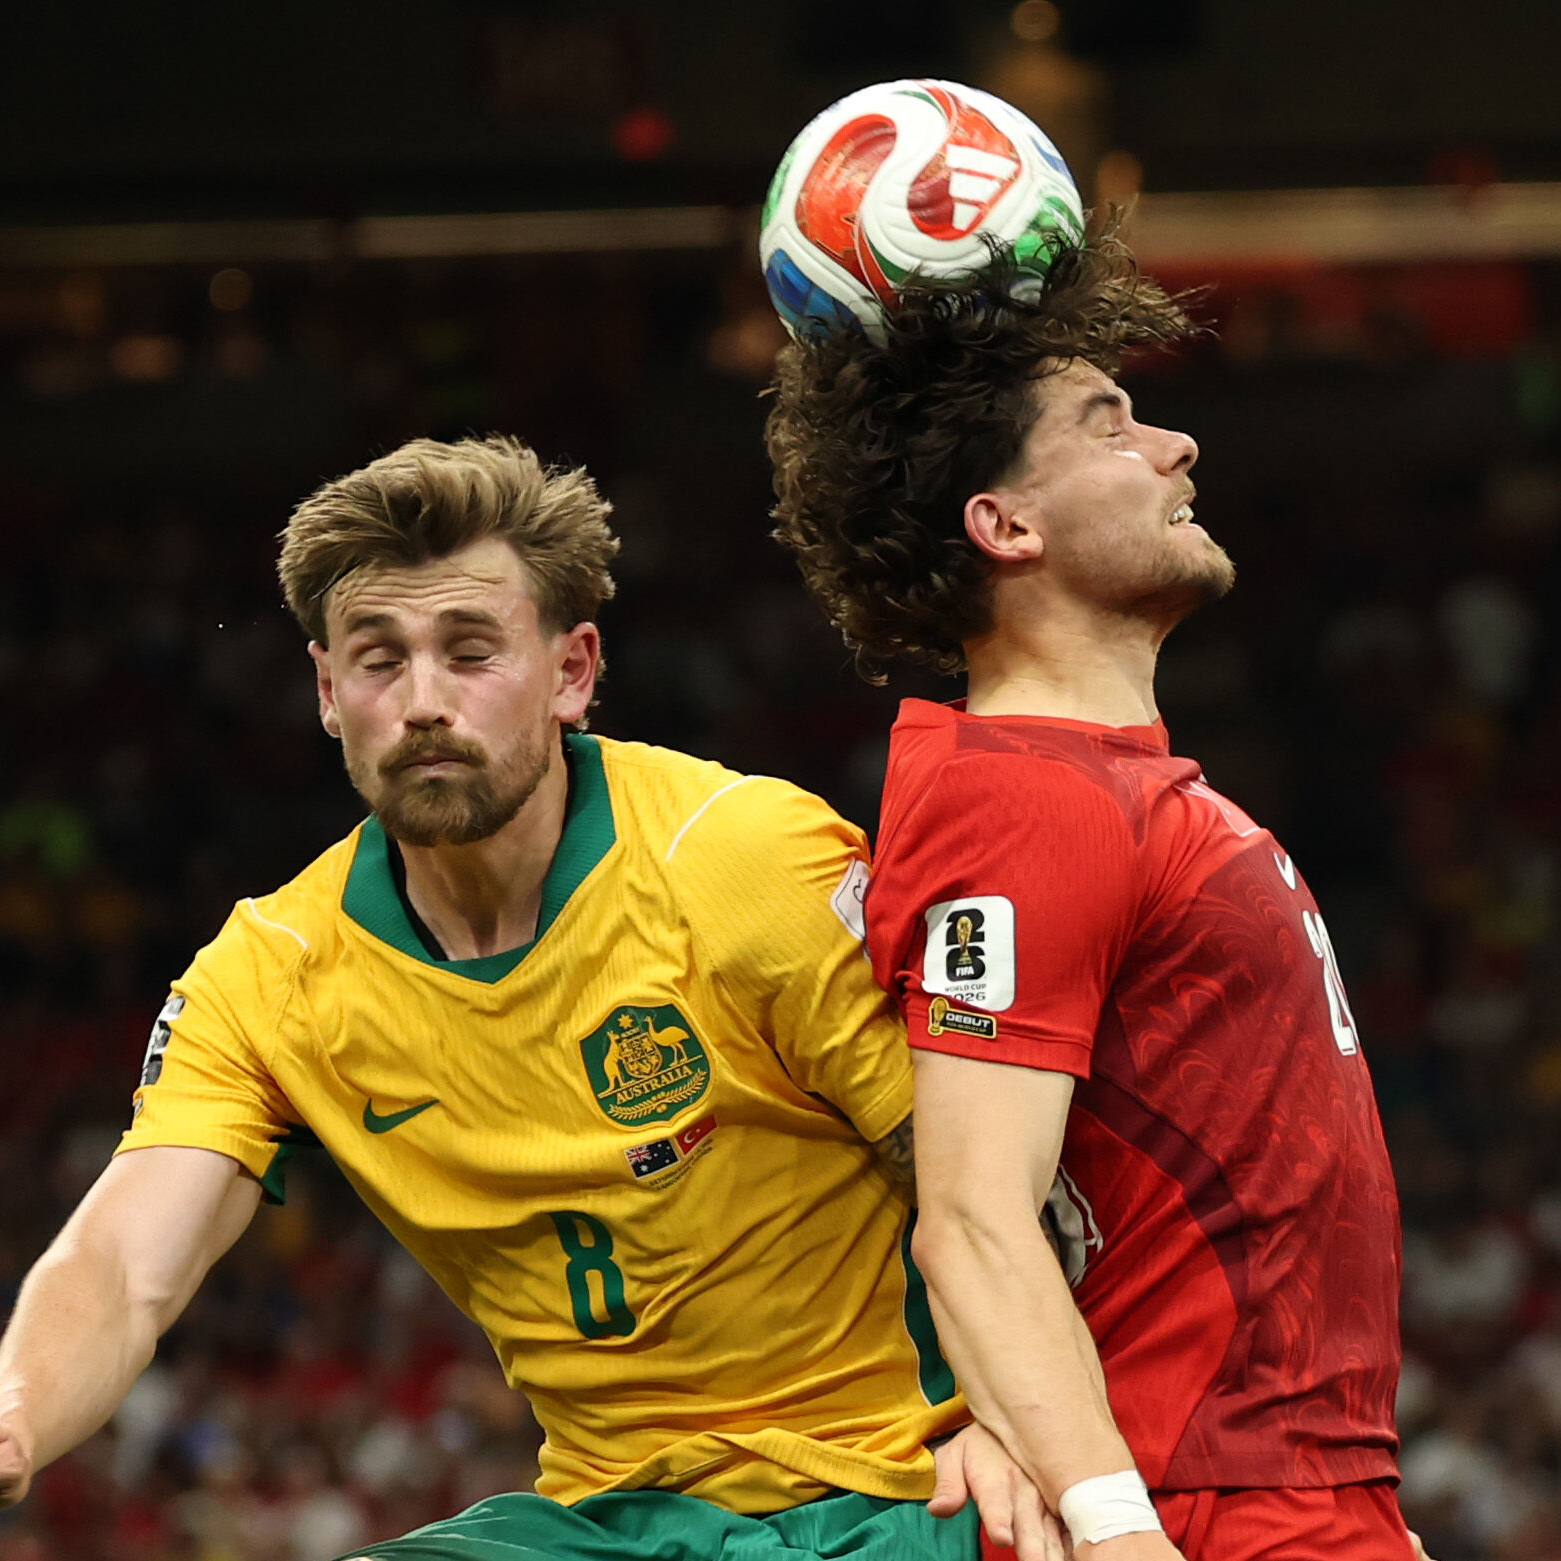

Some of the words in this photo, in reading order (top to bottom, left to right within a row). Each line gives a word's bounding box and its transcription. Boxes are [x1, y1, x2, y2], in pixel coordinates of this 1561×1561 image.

[955, 966, 975, 977] FIFA
[945, 985, 970, 993] WORLD
[971, 983, 987, 991] CUP
[953, 991, 986, 1002] 026
[945, 1012, 991, 1028] DEBUT
[616, 1065, 694, 1105] AUSTRALIA
[546, 1210, 636, 1339] 8
